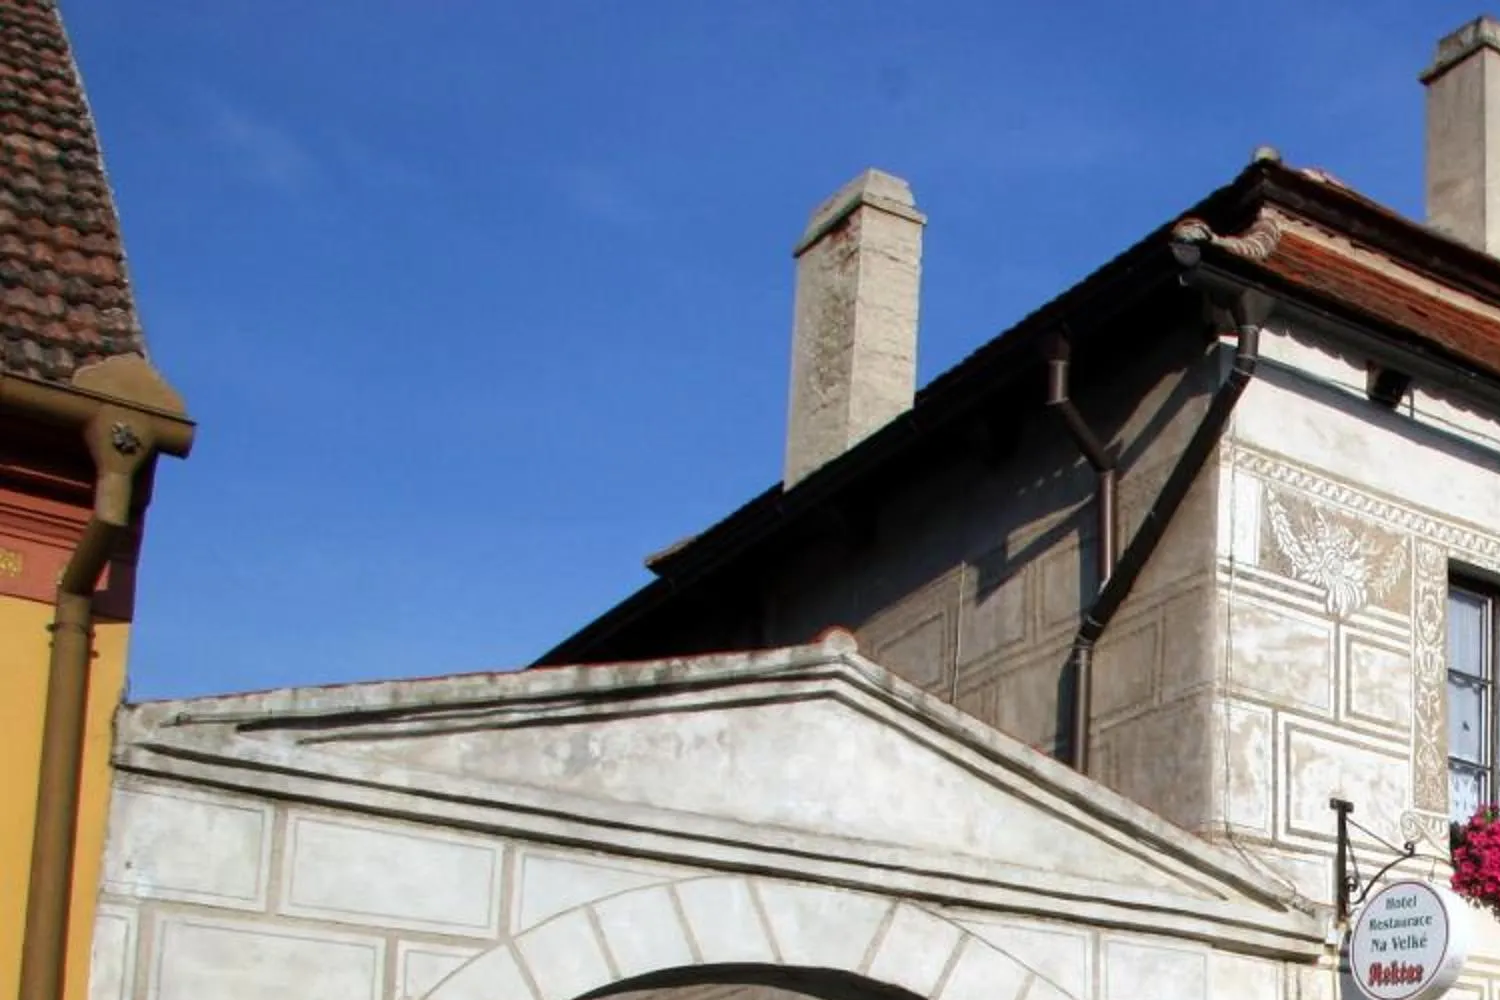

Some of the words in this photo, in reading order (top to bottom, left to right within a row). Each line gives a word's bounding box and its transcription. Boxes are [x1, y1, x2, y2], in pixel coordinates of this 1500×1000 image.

[1385, 896, 1417, 909] Hotel
[1369, 915, 1433, 931] Restaurace
[1371, 937, 1387, 952] Na
